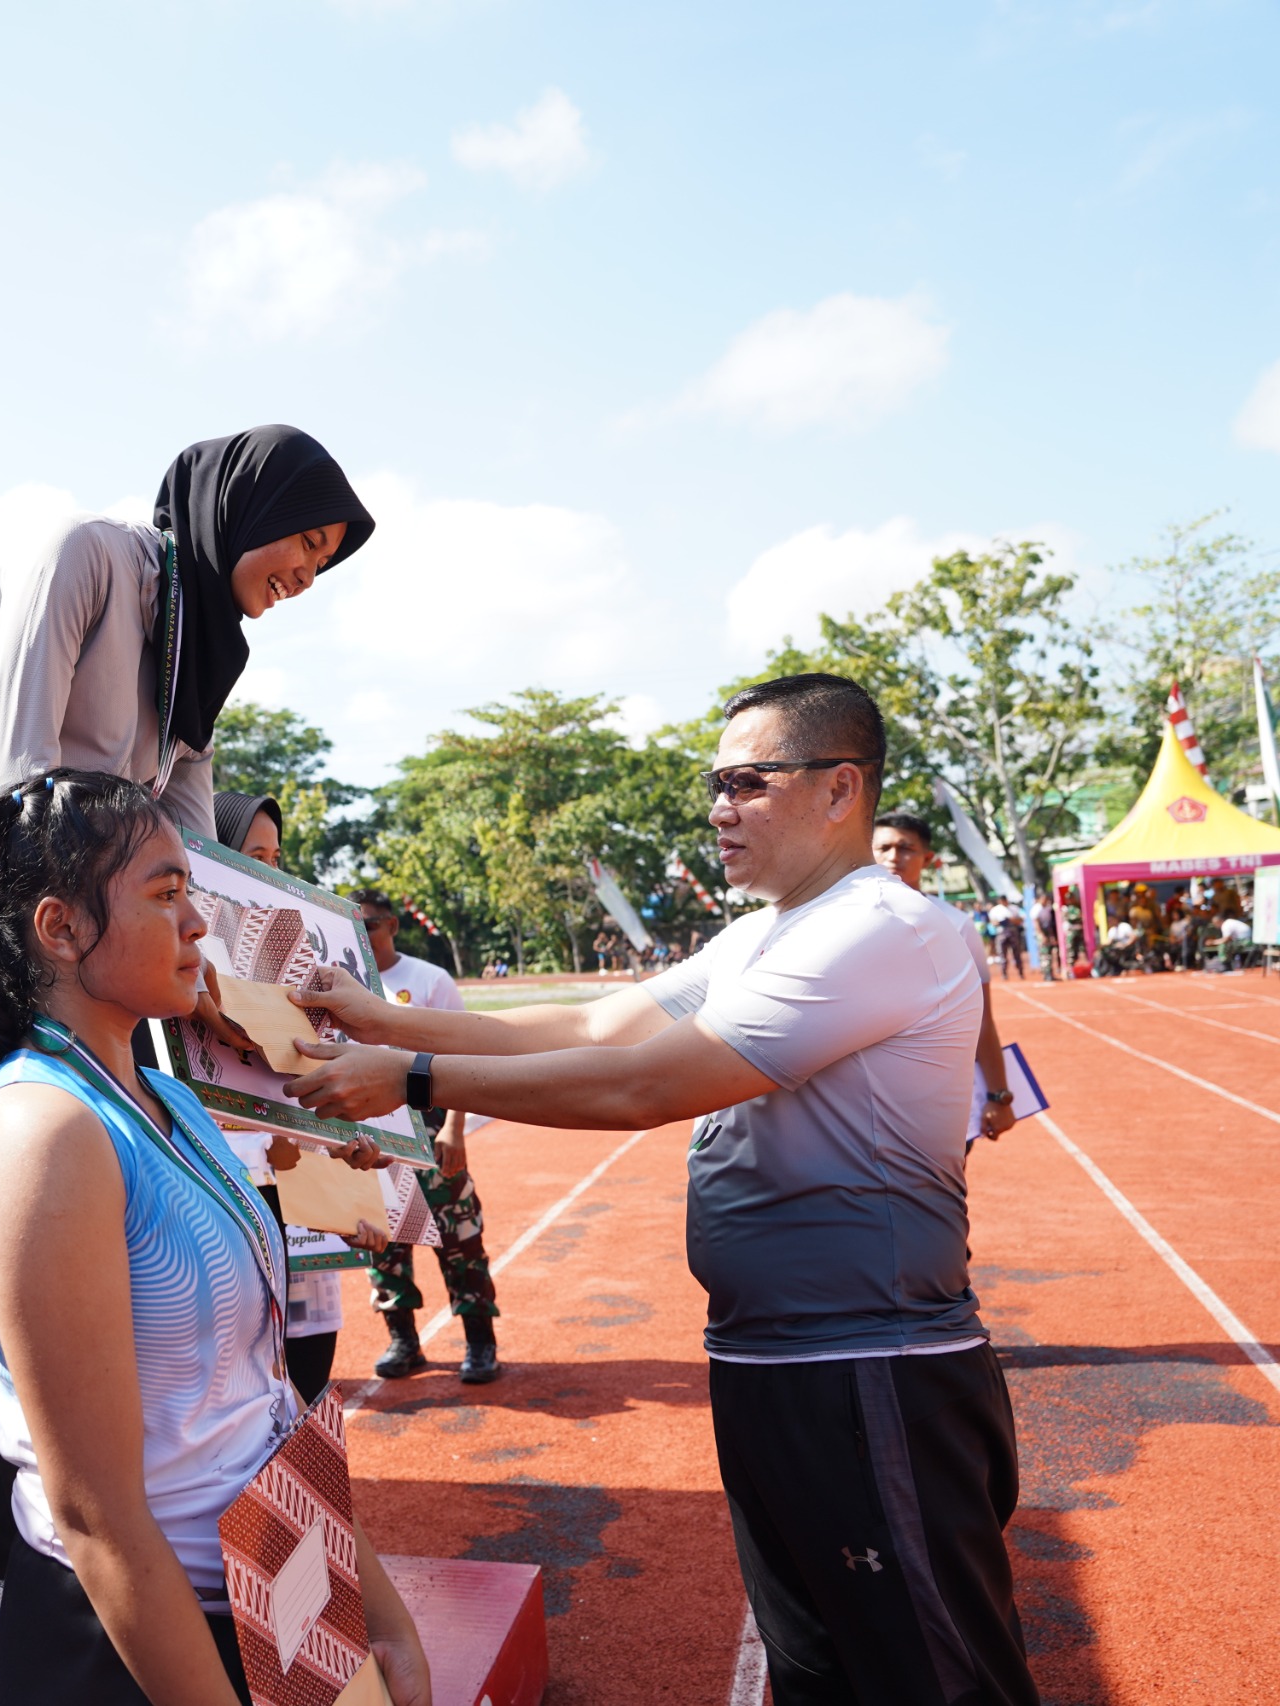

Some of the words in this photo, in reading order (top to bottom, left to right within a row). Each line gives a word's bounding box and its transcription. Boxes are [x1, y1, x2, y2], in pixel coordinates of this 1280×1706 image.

[1150, 858, 1221, 874] MABES
[1226, 854, 1262, 869] TNI
[286, 883, 306, 899] 2025
[253, 1102, 270, 1116] 80th
